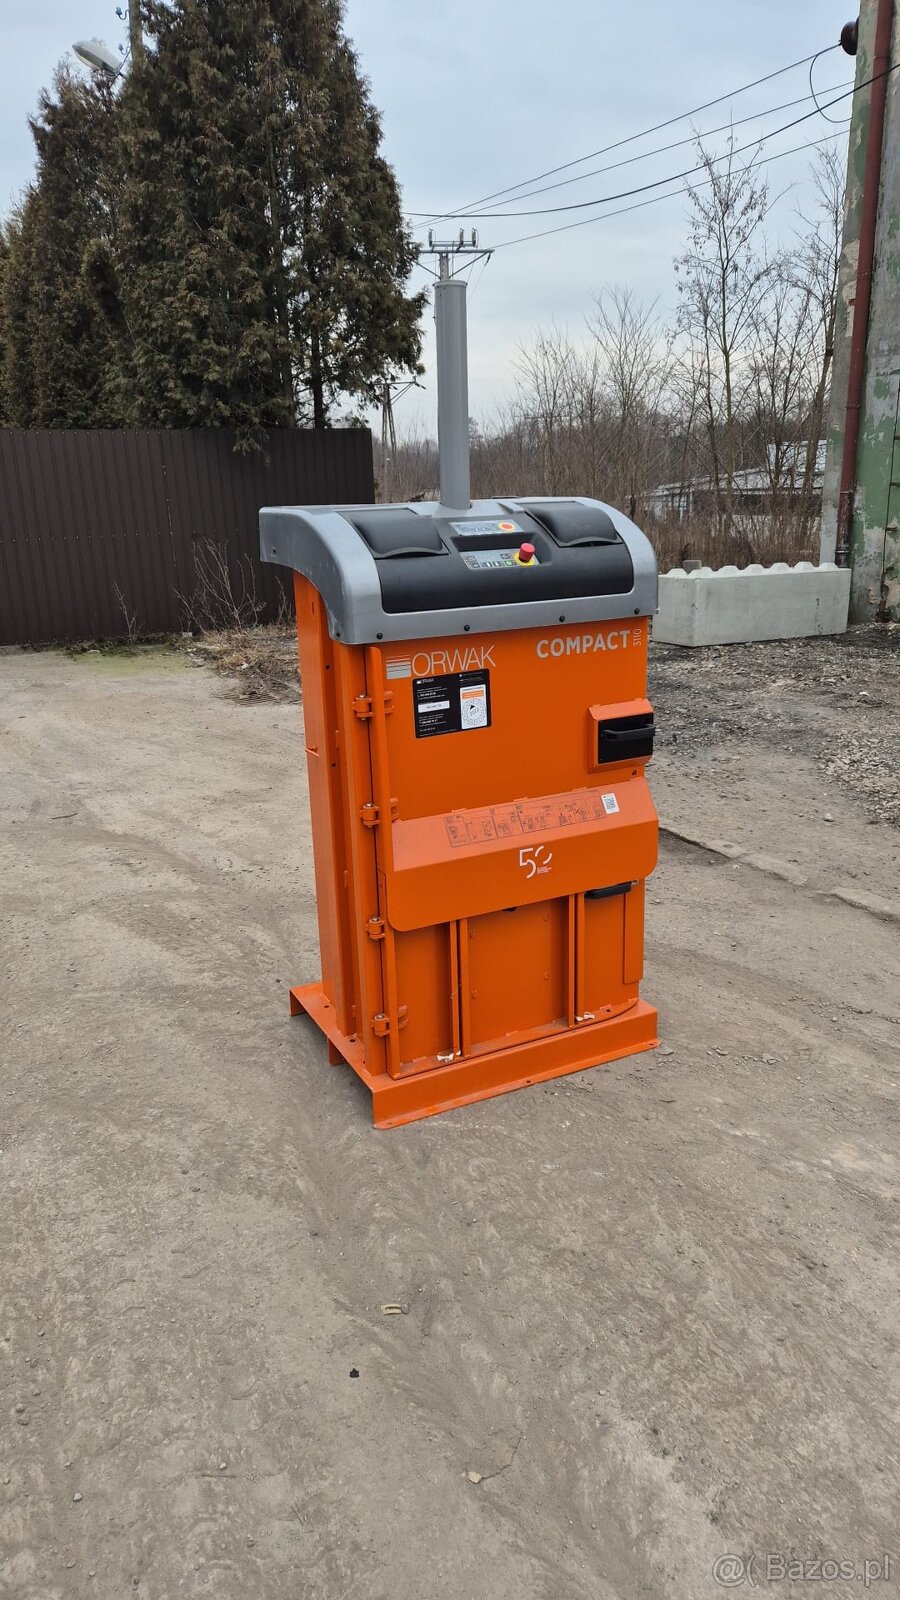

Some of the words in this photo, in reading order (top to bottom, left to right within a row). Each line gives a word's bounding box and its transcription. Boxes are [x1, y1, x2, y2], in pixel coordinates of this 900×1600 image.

[536, 630, 631, 659] COMPACT
[633, 628, 642, 647] 3110
[412, 644, 496, 676] ORWAK
